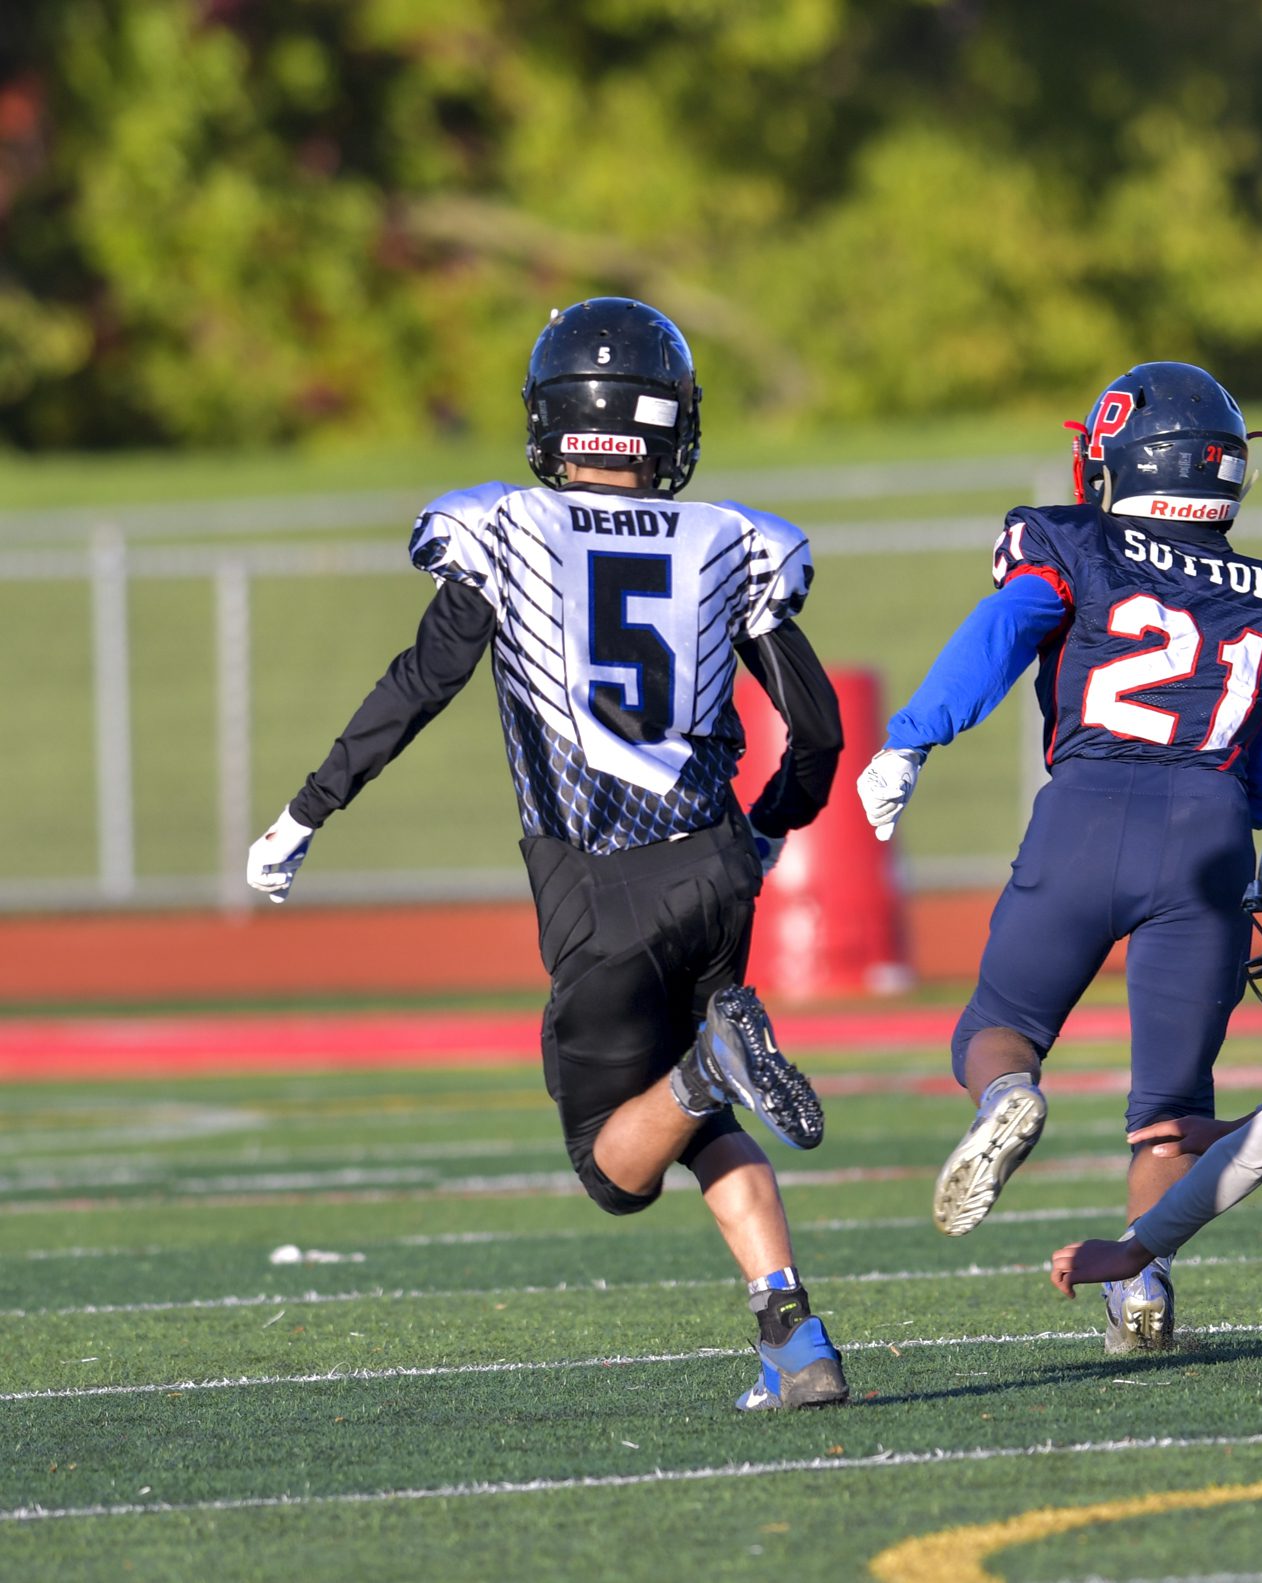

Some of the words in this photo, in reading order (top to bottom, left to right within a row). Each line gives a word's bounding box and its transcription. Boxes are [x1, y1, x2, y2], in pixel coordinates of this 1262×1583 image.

[596, 346, 612, 364] 5
[1088, 390, 1135, 461] P
[566, 436, 641, 454] Riddell
[1206, 444, 1223, 465] 21
[1150, 499, 1230, 519] Riddell
[568, 505, 680, 538] DEADY
[586, 550, 675, 745] 5
